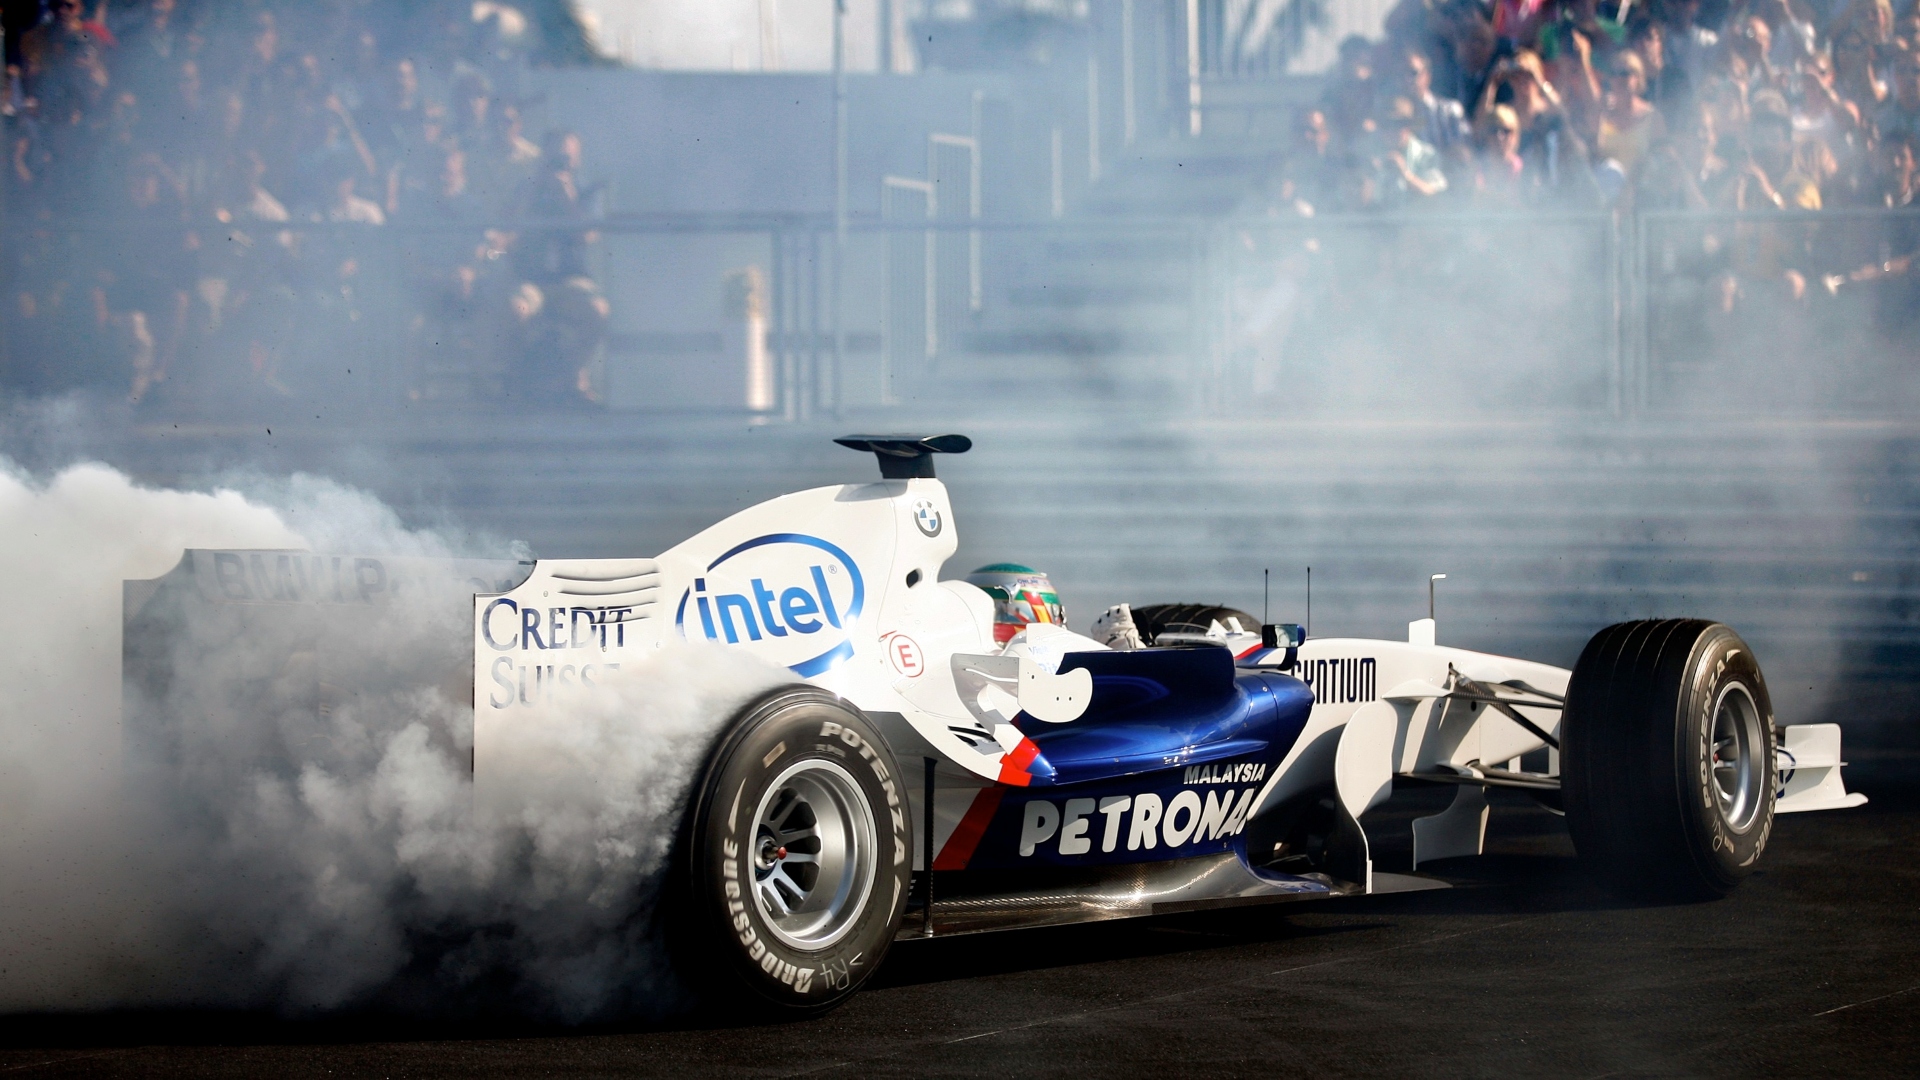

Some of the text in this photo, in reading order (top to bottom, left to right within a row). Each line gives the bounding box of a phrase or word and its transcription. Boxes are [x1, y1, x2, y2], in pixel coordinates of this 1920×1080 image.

[482, 598, 632, 651] CREDIT
[694, 565, 843, 644] intel
[490, 656, 621, 709] SUISS
[897, 645, 916, 667] E
[1700, 659, 1726, 809] POTENZA
[819, 721, 906, 867] POTENZA
[1183, 763, 1267, 785] MALAYSIA
[1019, 788, 1256, 857] PETRONA
[723, 837, 815, 994] BRIDGESTONE
